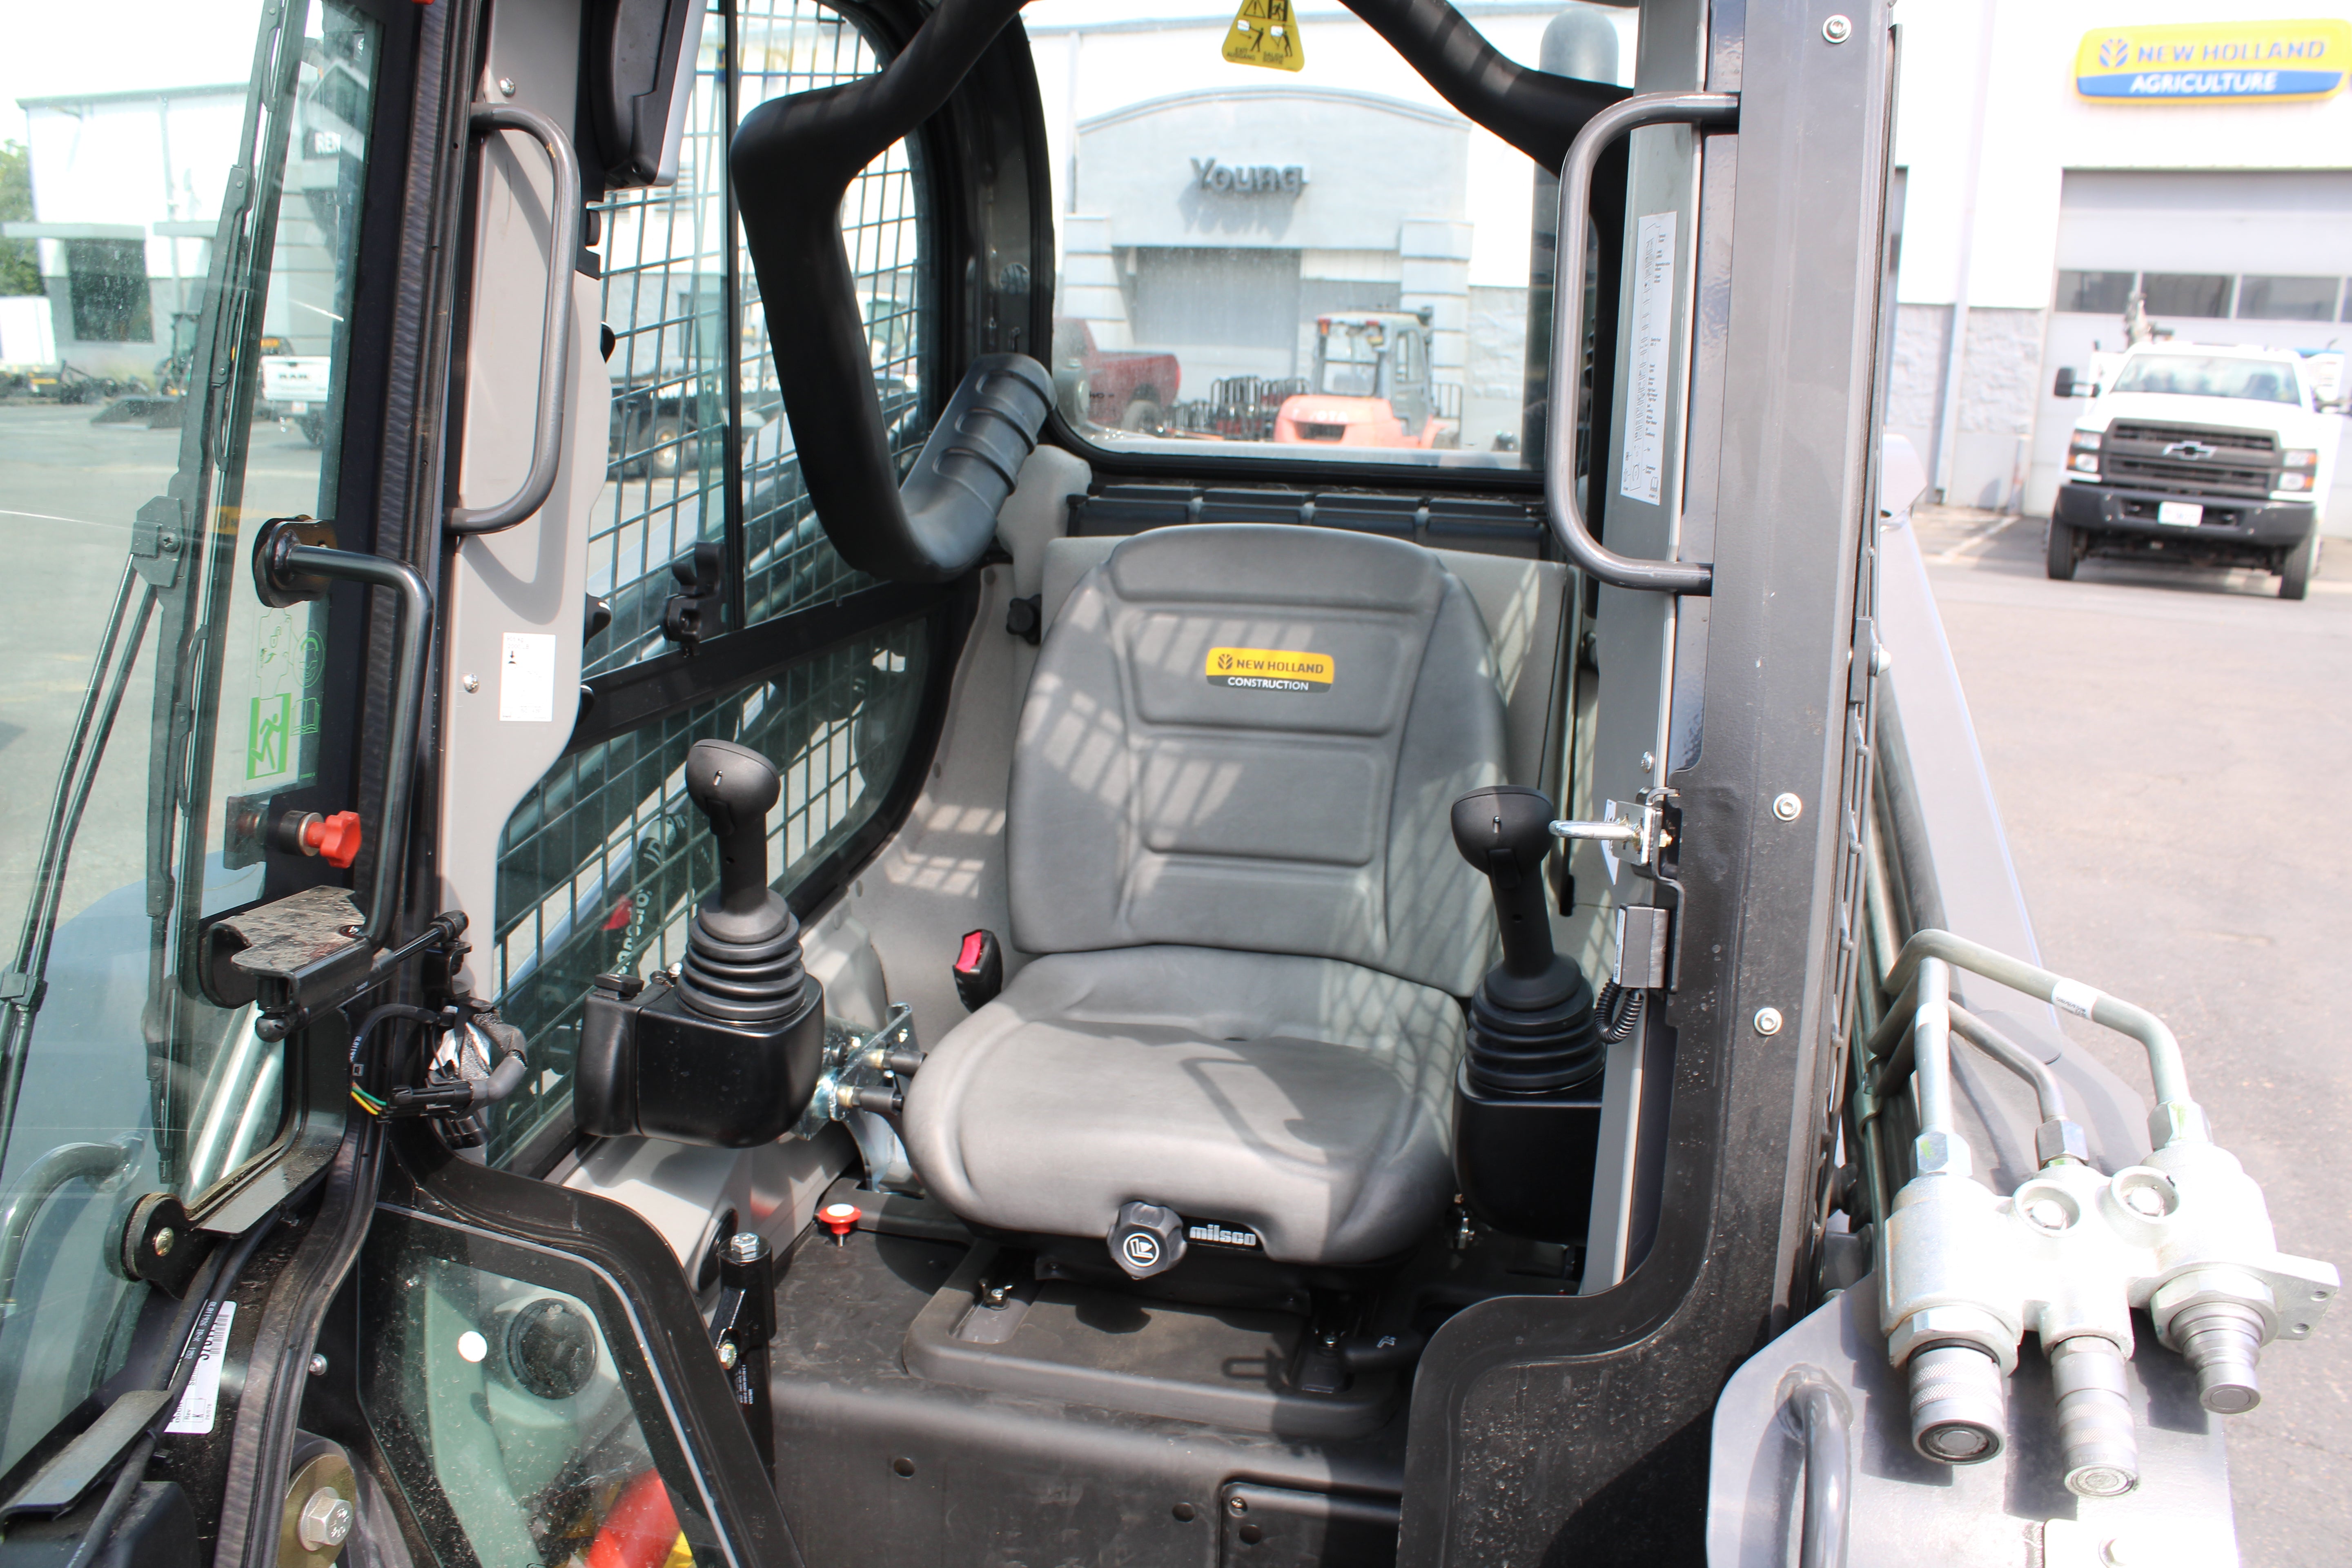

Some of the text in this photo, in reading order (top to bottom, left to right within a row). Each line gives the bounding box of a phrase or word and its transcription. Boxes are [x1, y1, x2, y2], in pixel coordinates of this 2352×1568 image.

[2138, 40, 2326, 63] NEW HOLLAND
[2129, 70, 2280, 94] AGRICULTURE
[1189, 157, 1307, 197] Young
[1236, 659, 1324, 673] NEW HOLLAND
[1227, 676, 1309, 690] CONSTRUCTION
[1189, 1224, 1256, 1246] milsco
